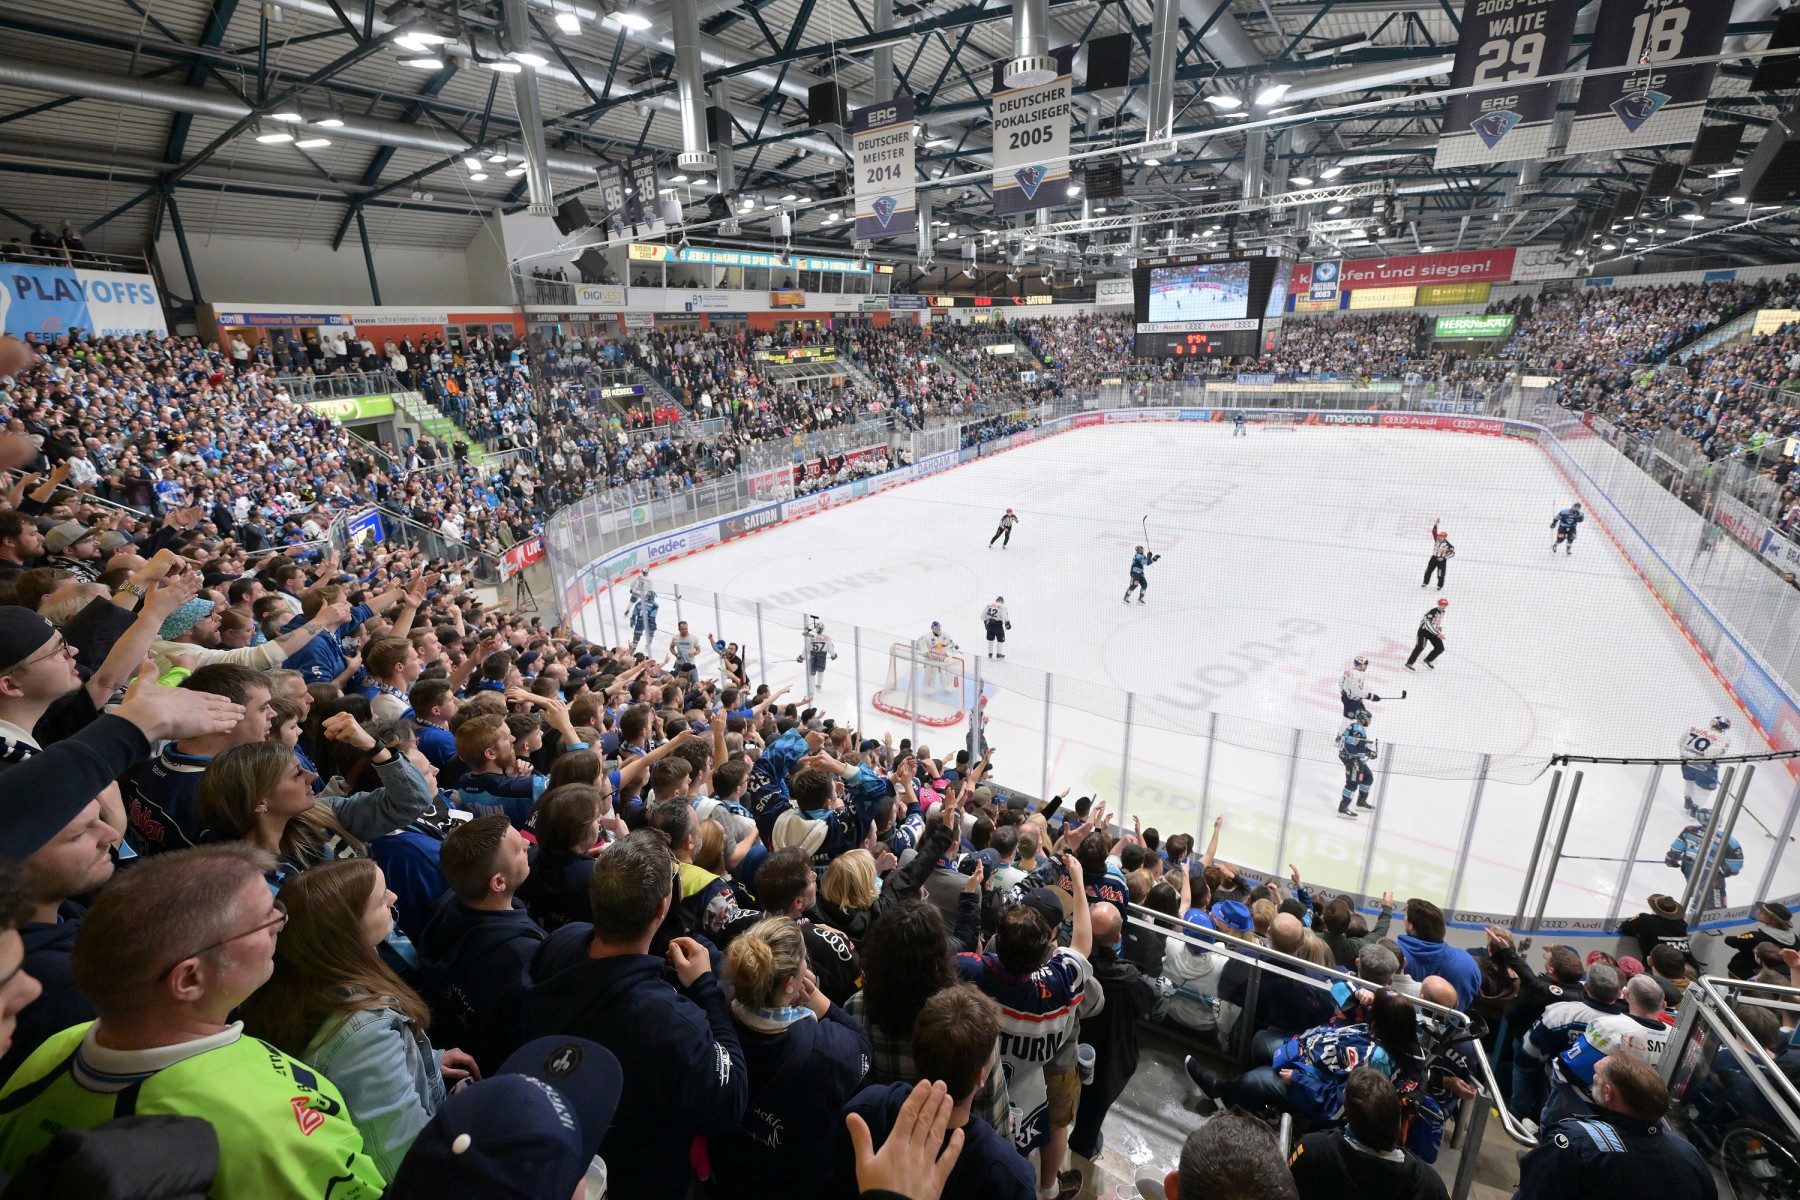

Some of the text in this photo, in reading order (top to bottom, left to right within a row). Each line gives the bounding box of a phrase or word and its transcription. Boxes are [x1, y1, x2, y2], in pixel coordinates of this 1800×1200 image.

[1489, 10, 1547, 38] WAITE
[1626, 7, 1691, 67] 18
[1473, 32, 1547, 86] 29
[1622, 74, 1667, 89] ERC
[1000, 87, 1066, 113] DEUTSCHER
[1481, 95, 1519, 109] ERC
[868, 107, 897, 123] ERC
[994, 103, 1070, 130] POKALSIEGER
[858, 131, 910, 151] DEUTSCHER
[1009, 124, 1053, 150] 2005
[863, 148, 905, 164] MEISTER
[634, 165, 654, 179] FICENEC
[866, 163, 902, 184] 2014
[636, 176, 656, 202] 38
[605, 186, 622, 211] 96
[1210, 252, 1230, 260] SATURN
[1243, 249, 1264, 257] SATURN
[1380, 266, 1416, 279] und
[1420, 259, 1492, 277] siegen!
[11, 274, 156, 305] PLAYOFFS
[583, 291, 621, 300] DIGIVEST
[1026, 295, 1053, 305] SATURN
[377, 315, 448, 326] schreinerei-mayr.de
[1190, 344, 1197, 354] 3
[611, 387, 635, 396] KESSEL
[1325, 414, 1374, 424] macron
[1410, 416, 1438, 425] Audi
[1478, 420, 1502, 431] Audi
[743, 508, 778, 530] SATURN
[647, 537, 686, 559] leadec
[987, 607, 998, 618] 42
[812, 641, 826, 651] 57
[1685, 732, 1712, 752] 70
[1239, 868, 1263, 882] Audi
[1319, 889, 1337, 899] Au
[1724, 909, 1748, 919] Audi
[1483, 917, 1513, 926] Audi
[1572, 920, 1602, 929] Audi
